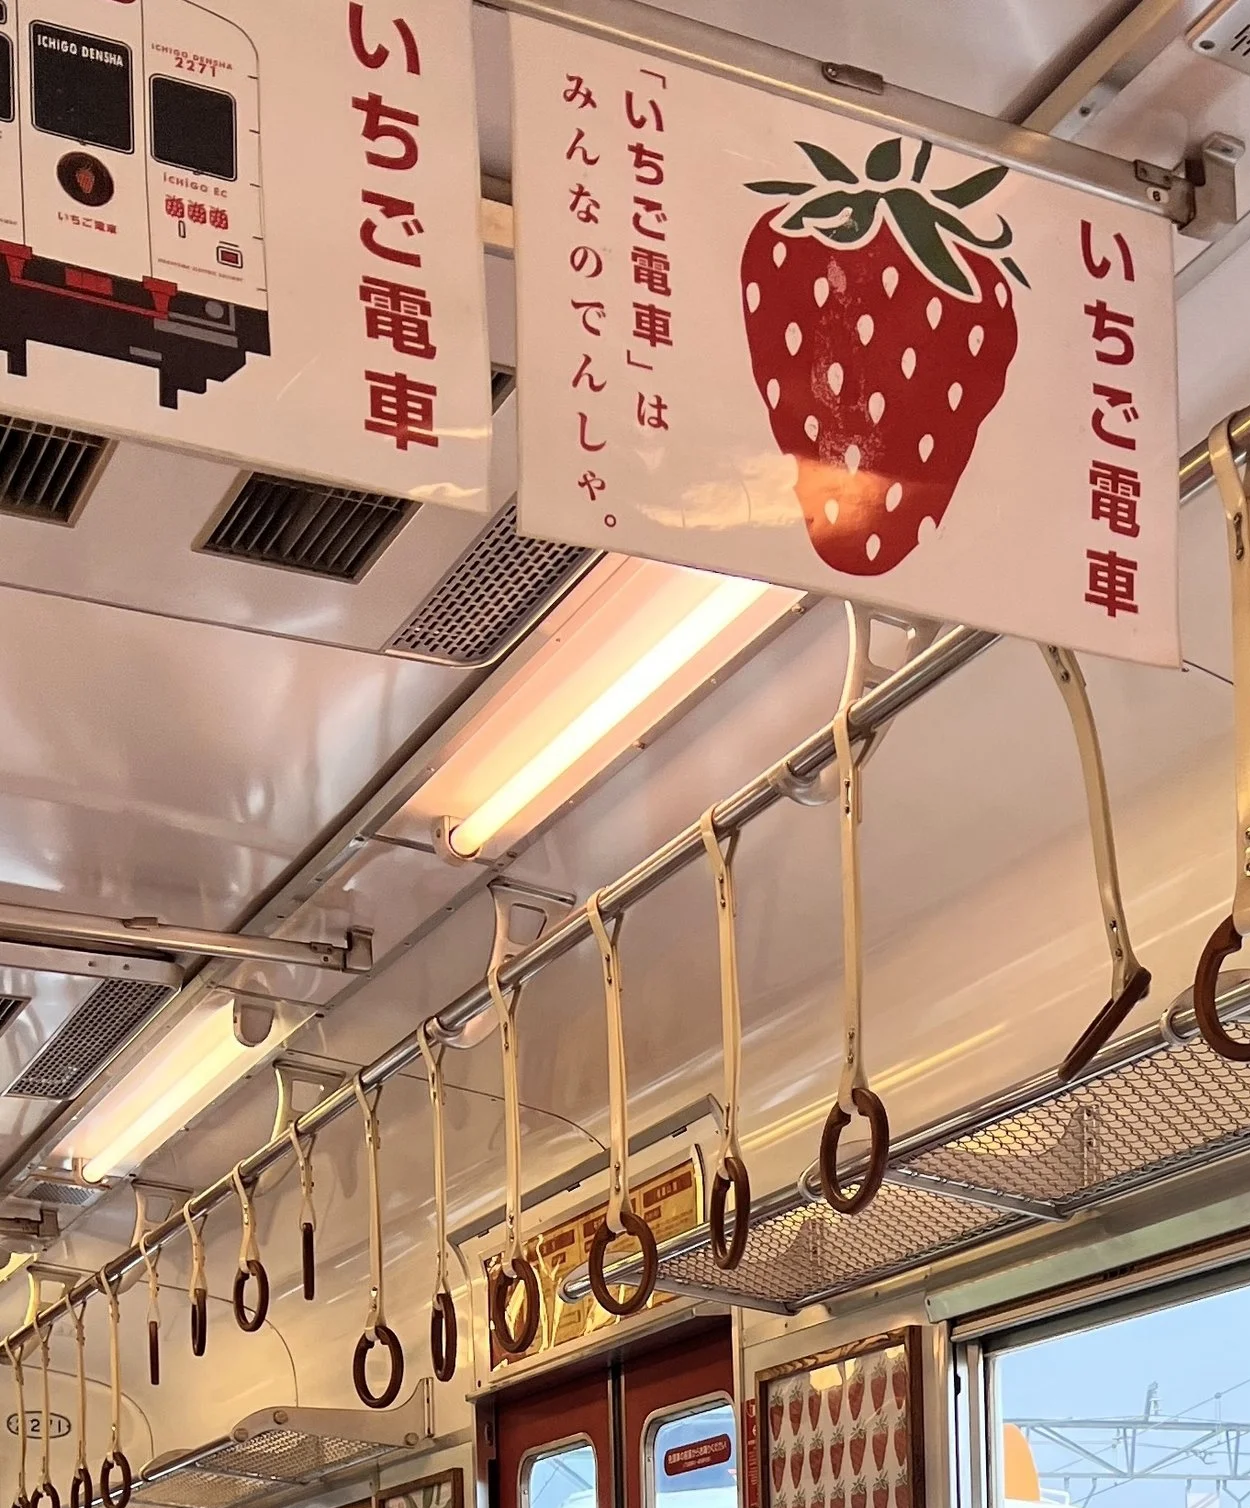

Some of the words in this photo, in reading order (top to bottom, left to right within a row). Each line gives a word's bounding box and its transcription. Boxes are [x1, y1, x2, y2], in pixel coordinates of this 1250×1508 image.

[36, 34, 78, 56] ICHIGO
[81, 46, 124, 67] DENSHA
[151, 43, 189, 59] ICHIGO
[192, 54, 233, 70] DENSHA
[174, 56, 217, 78] 2271
[347, 2, 440, 452] いちご電車
[562, 73, 617, 529] みんなのでんしゃ。
[624, 68, 674, 432] 「いちご電車」は
[1079, 219, 1142, 619] いちご電車
[15, 1418, 62, 1434] 21
